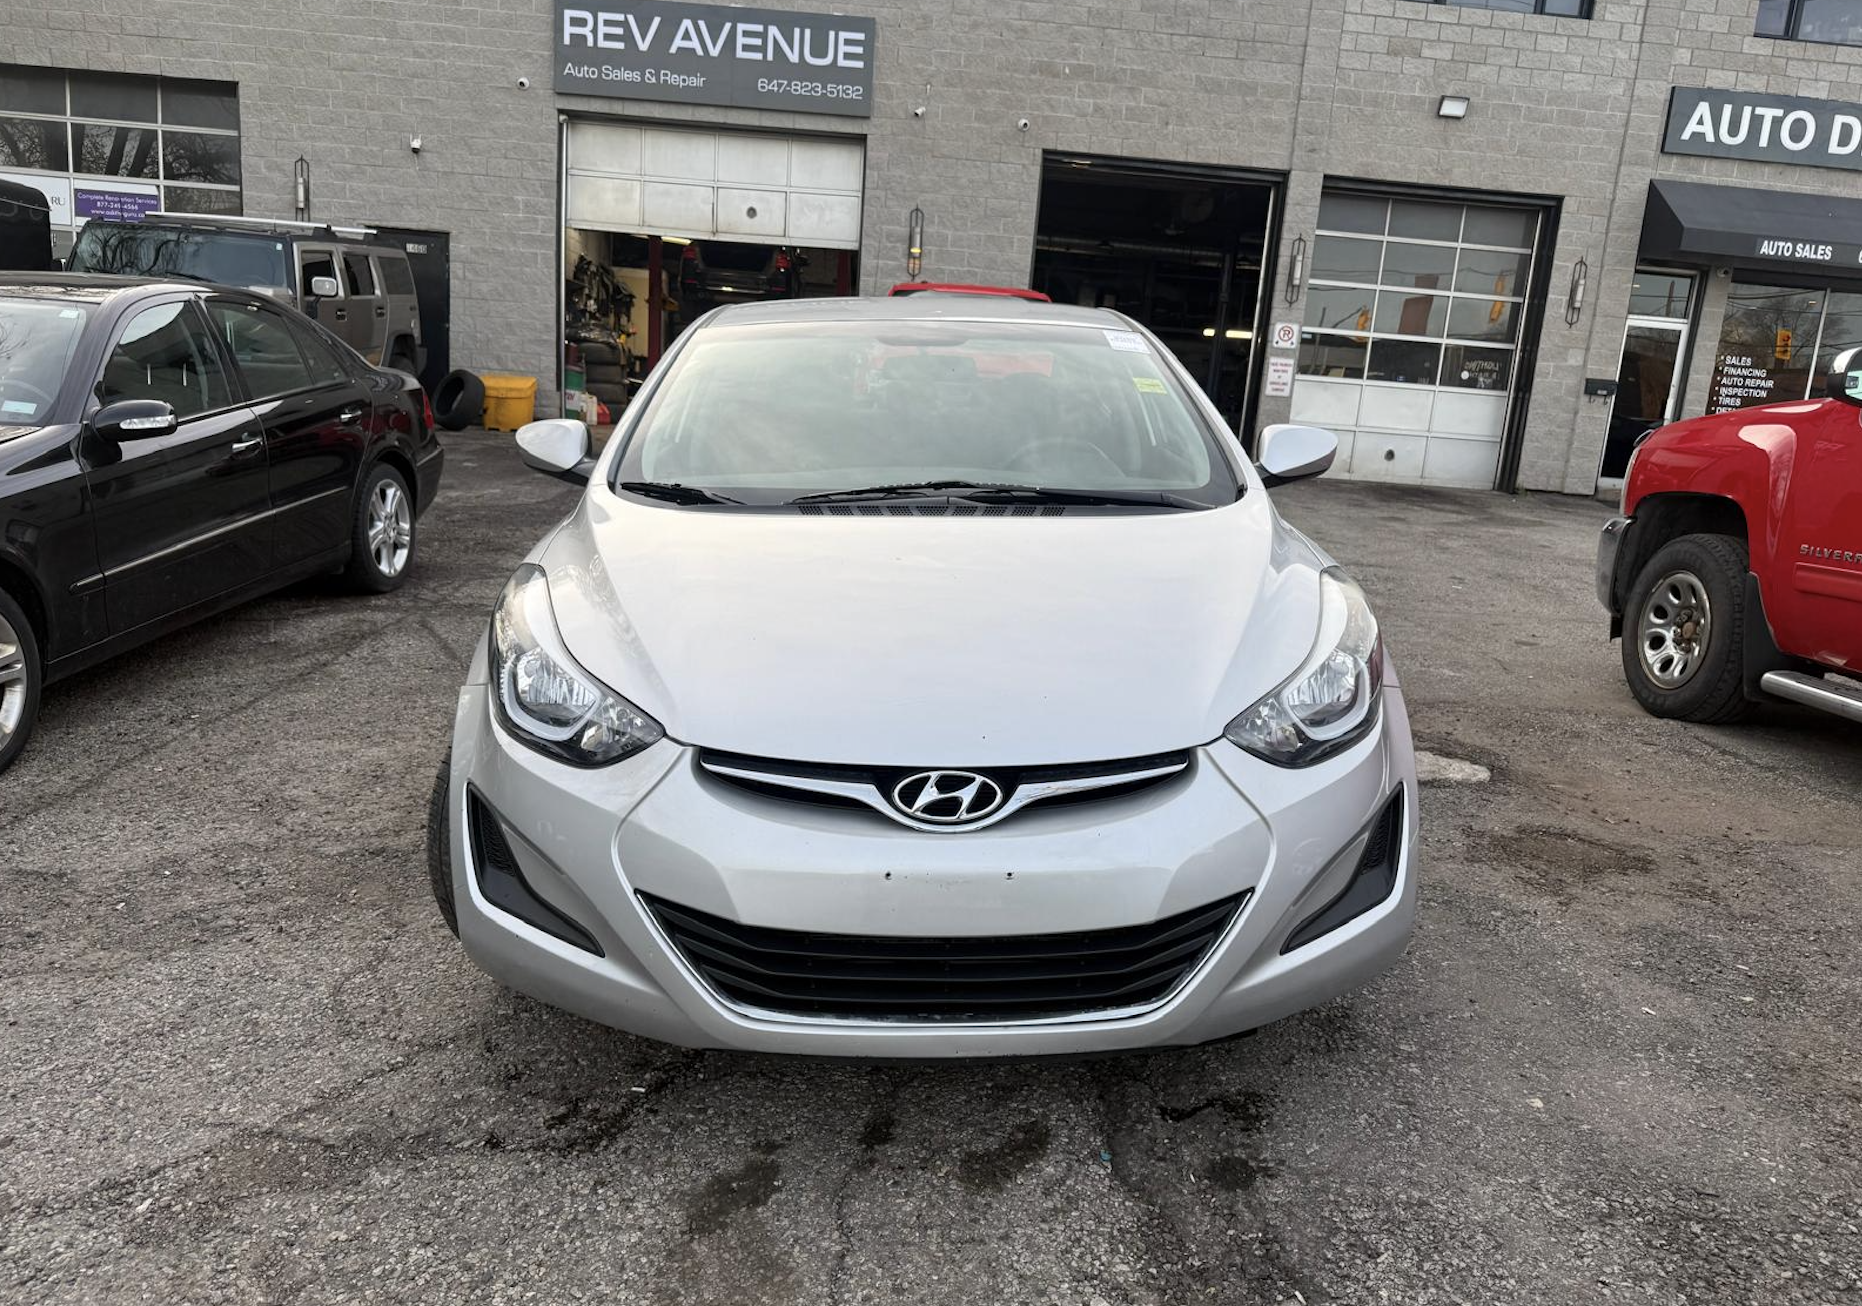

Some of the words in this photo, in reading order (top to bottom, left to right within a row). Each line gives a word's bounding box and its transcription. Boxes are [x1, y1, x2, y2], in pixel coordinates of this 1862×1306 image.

[563, 9, 661, 52] REV
[668, 18, 866, 69] AVENUE
[563, 62, 598, 79] Auto
[601, 64, 641, 83] Sales
[644, 69, 657, 84] &
[660, 70, 707, 89] Repair
[757, 78, 863, 100] 647-823-5132
[1680, 101, 1817, 151] AUTO
[1827, 114, 1862, 155] D
[51, 196, 65, 206] RU
[77, 192, 104, 202] Complete
[135, 196, 157, 205] Services
[1759, 240, 1793, 257] AUTO
[1795, 243, 1833, 260] SALES
[1725, 355, 1752, 366] SALES
[1723, 366, 1767, 378] FINANCING
[1720, 376, 1743, 387] AUTO
[1744, 378, 1774, 389] REPAIR
[1719, 386, 1768, 398] INSPECTION
[1718, 396, 1741, 406] TIRES
